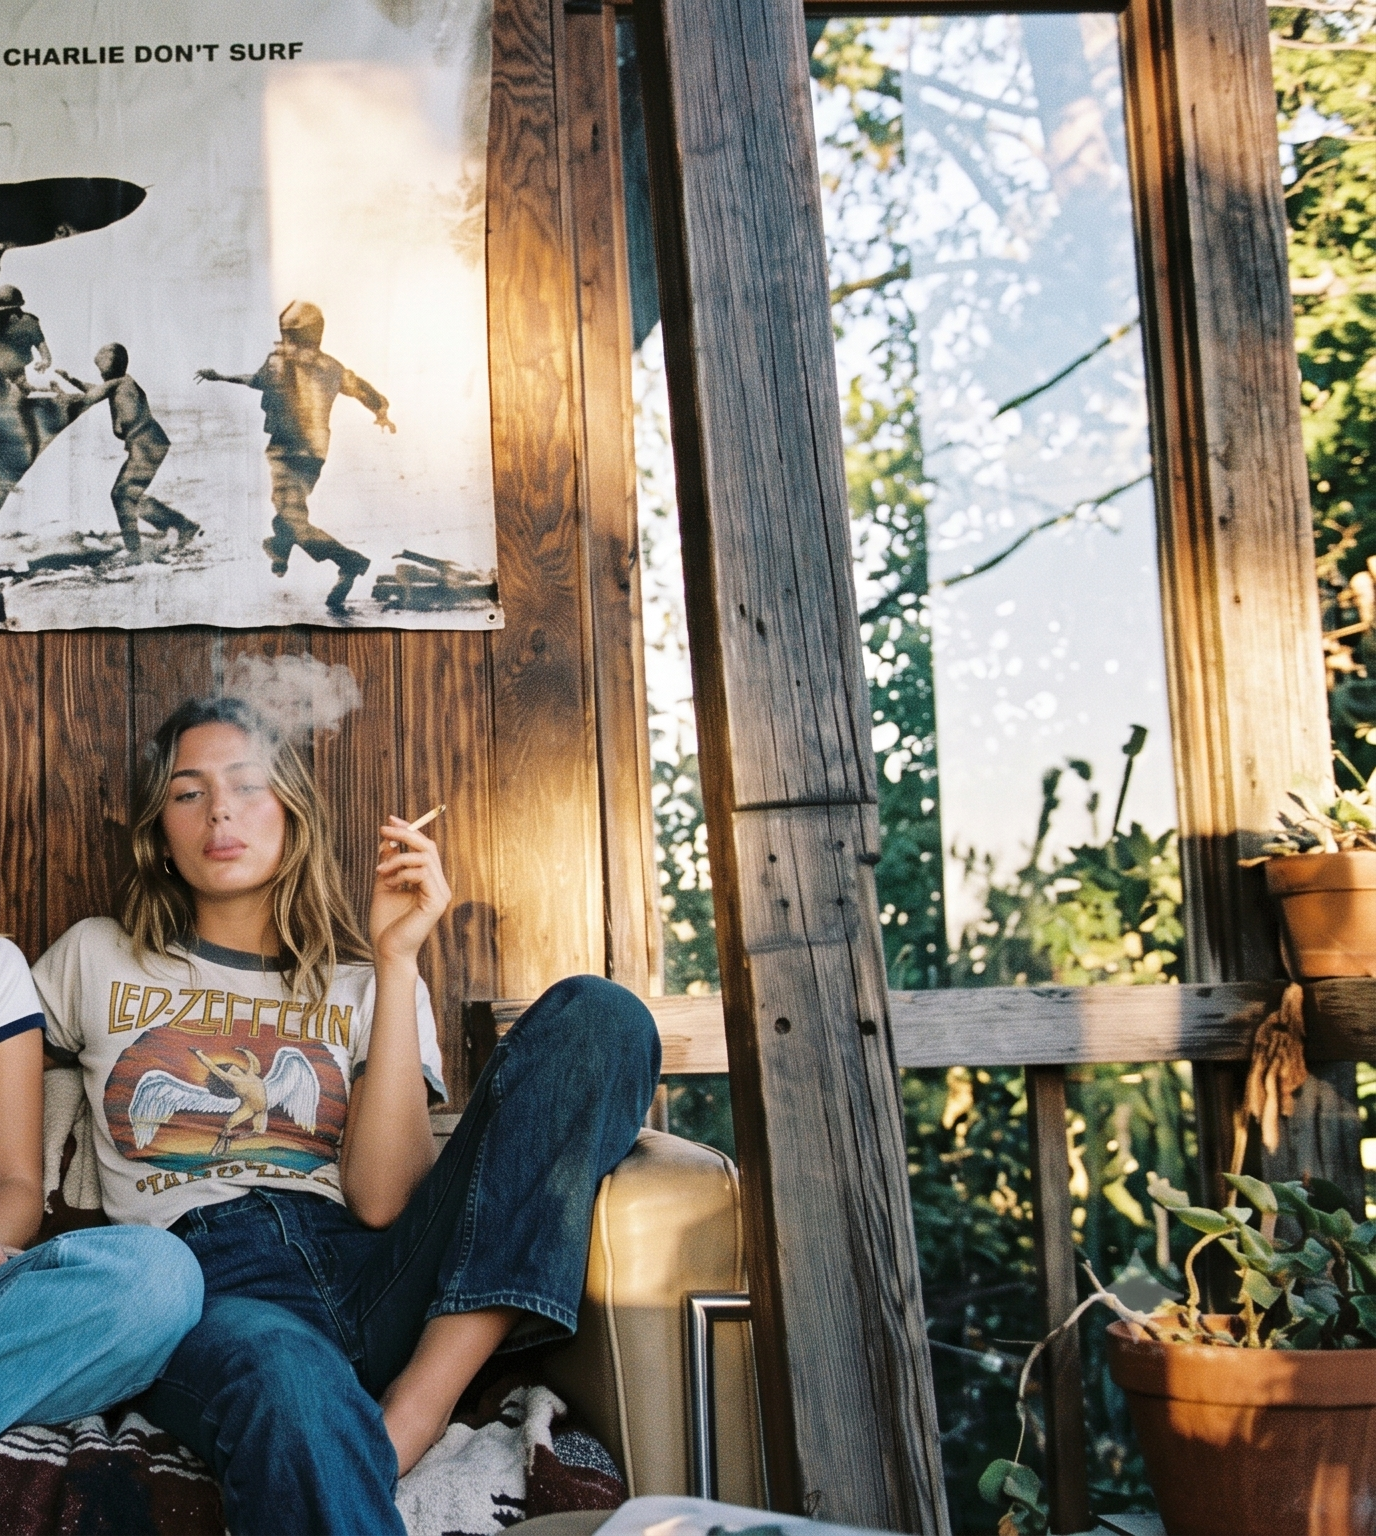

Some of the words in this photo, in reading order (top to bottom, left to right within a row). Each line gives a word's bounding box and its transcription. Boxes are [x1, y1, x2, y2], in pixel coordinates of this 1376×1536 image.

[3, 46, 125, 66] CHARLIE
[134, 44, 219, 63] DON'T
[229, 42, 304, 62] SURF
